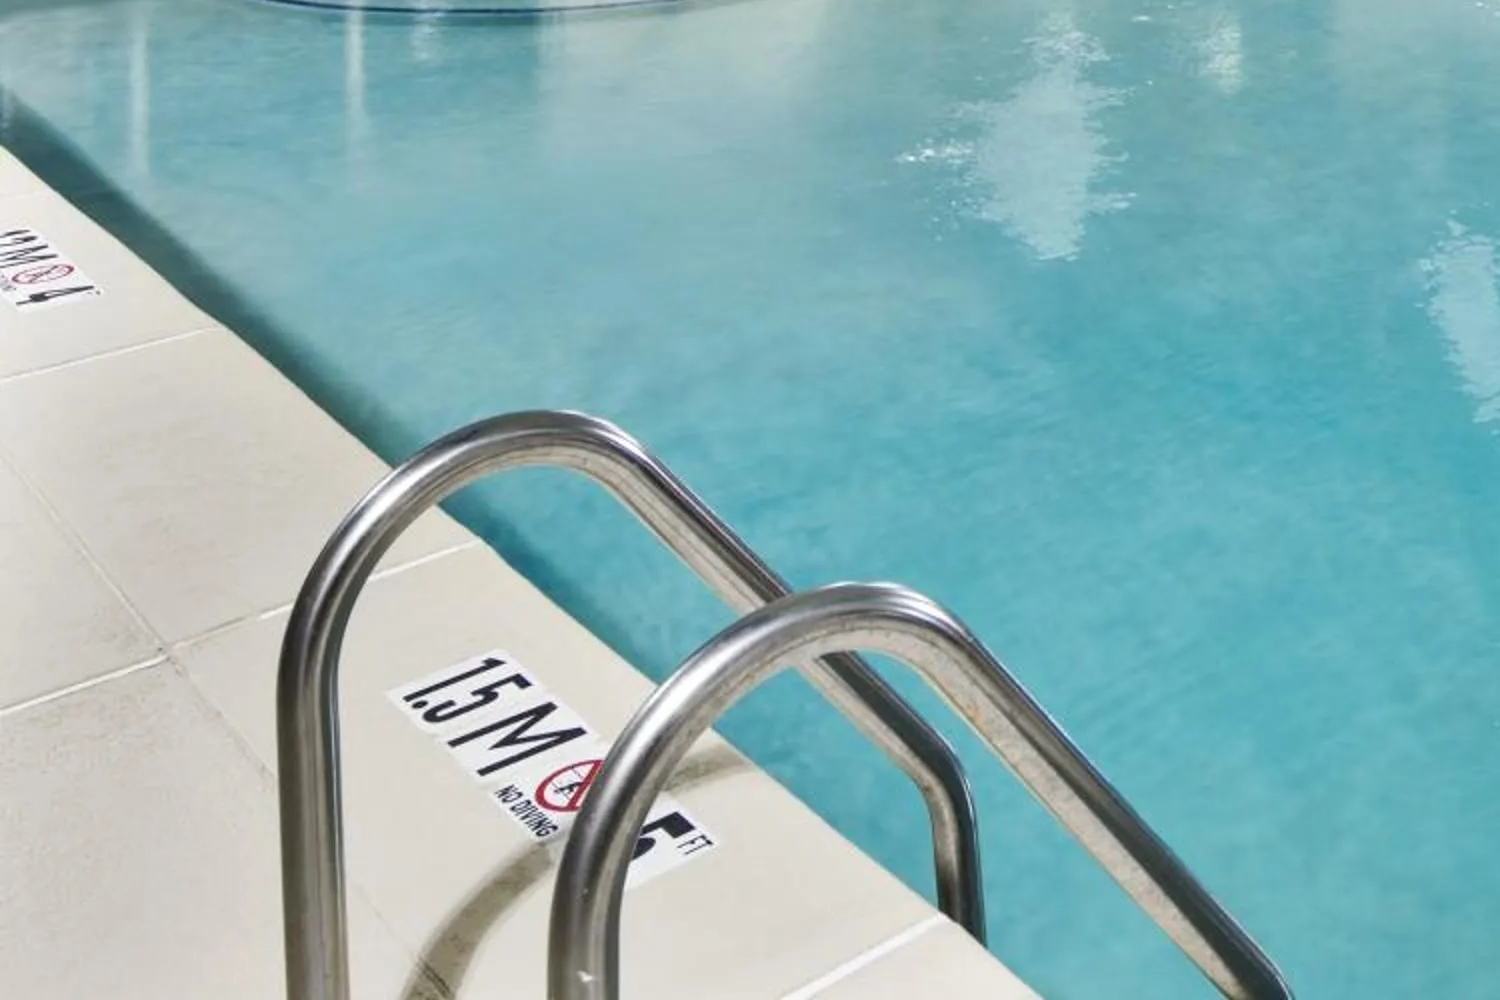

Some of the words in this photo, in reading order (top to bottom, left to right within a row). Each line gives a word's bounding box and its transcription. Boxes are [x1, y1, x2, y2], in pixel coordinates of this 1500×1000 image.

[16, 285, 95, 306] 4
[494, 783, 523, 803] NO
[510, 799, 559, 836] DIVING
[677, 835, 714, 856] FT
